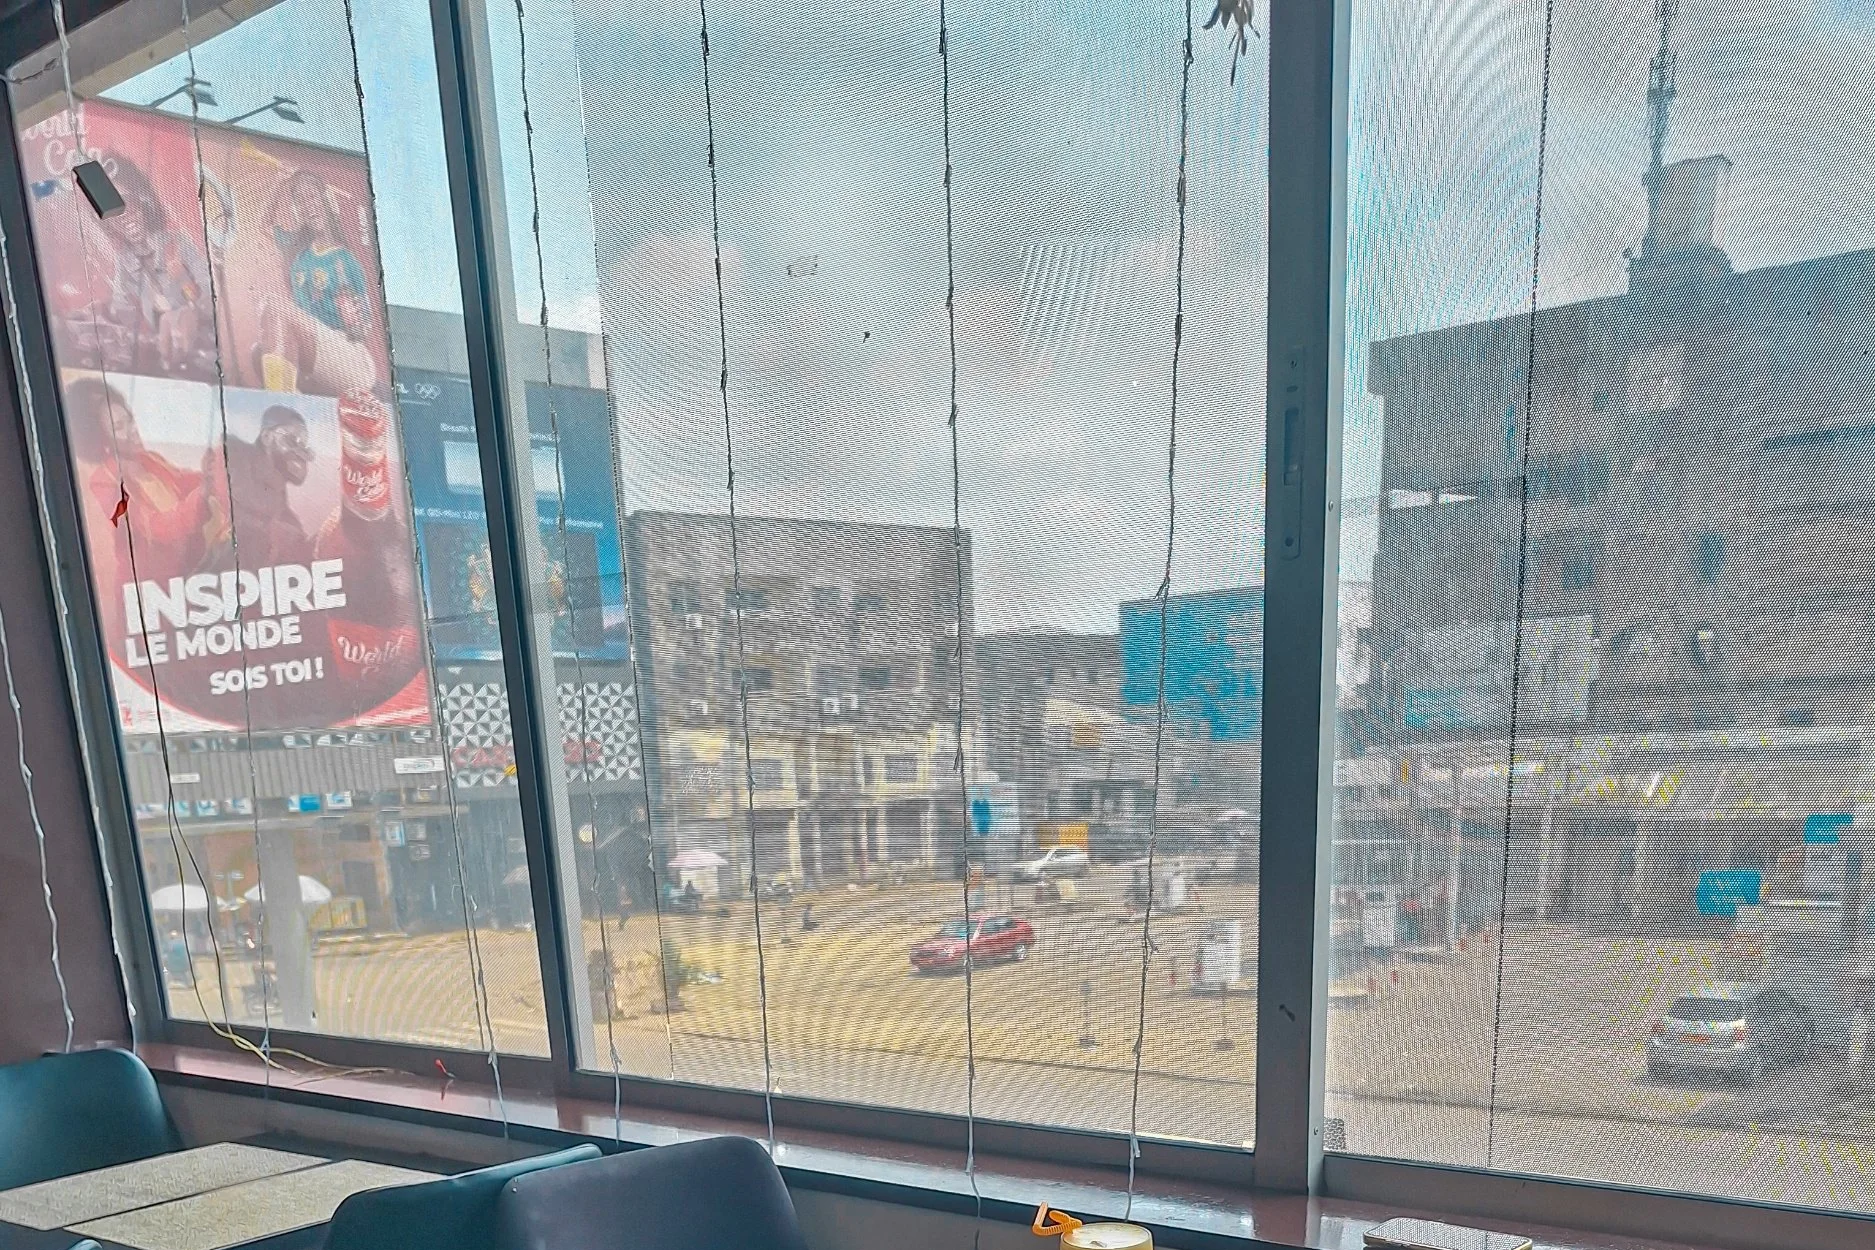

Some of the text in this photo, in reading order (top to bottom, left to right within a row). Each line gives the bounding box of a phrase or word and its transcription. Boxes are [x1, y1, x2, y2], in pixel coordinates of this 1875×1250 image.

[123, 558, 347, 635] INSPIRE
[125, 615, 302, 669] LE MONDE
[210, 665, 268, 695] SOIS
